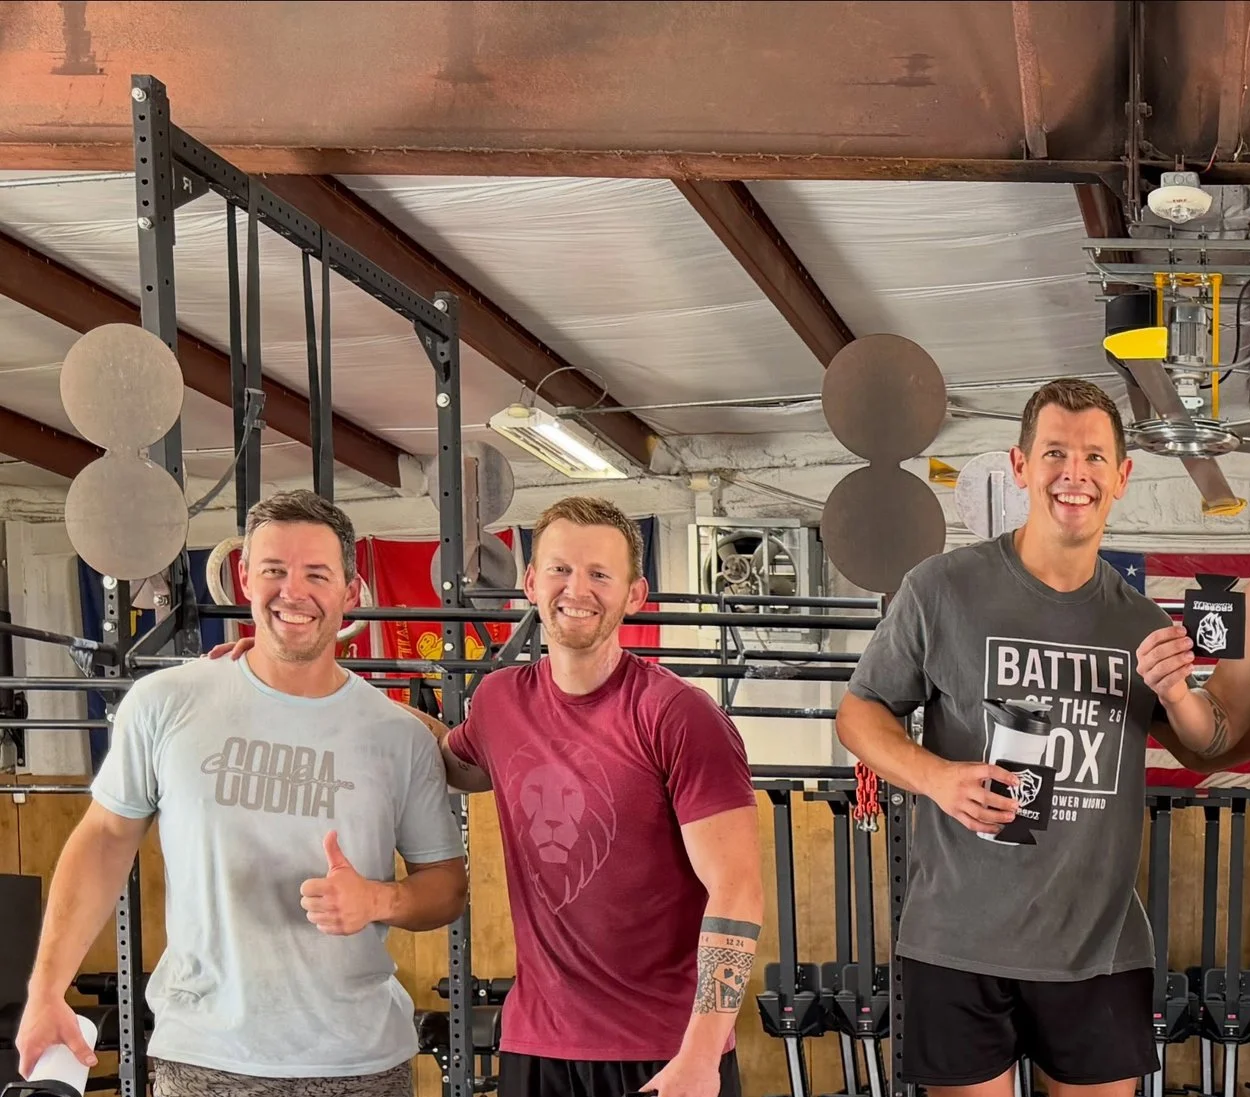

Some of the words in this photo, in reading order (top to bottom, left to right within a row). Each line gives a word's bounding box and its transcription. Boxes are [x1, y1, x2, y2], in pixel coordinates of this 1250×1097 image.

[996, 646, 1124, 697] BATTLE
[1059, 697, 1101, 727] THE
[1108, 708, 1122, 723] 26
[1045, 727, 1105, 785] OX
[1051, 795, 1079, 808] OWER
[1052, 808, 1078, 822] 2008
